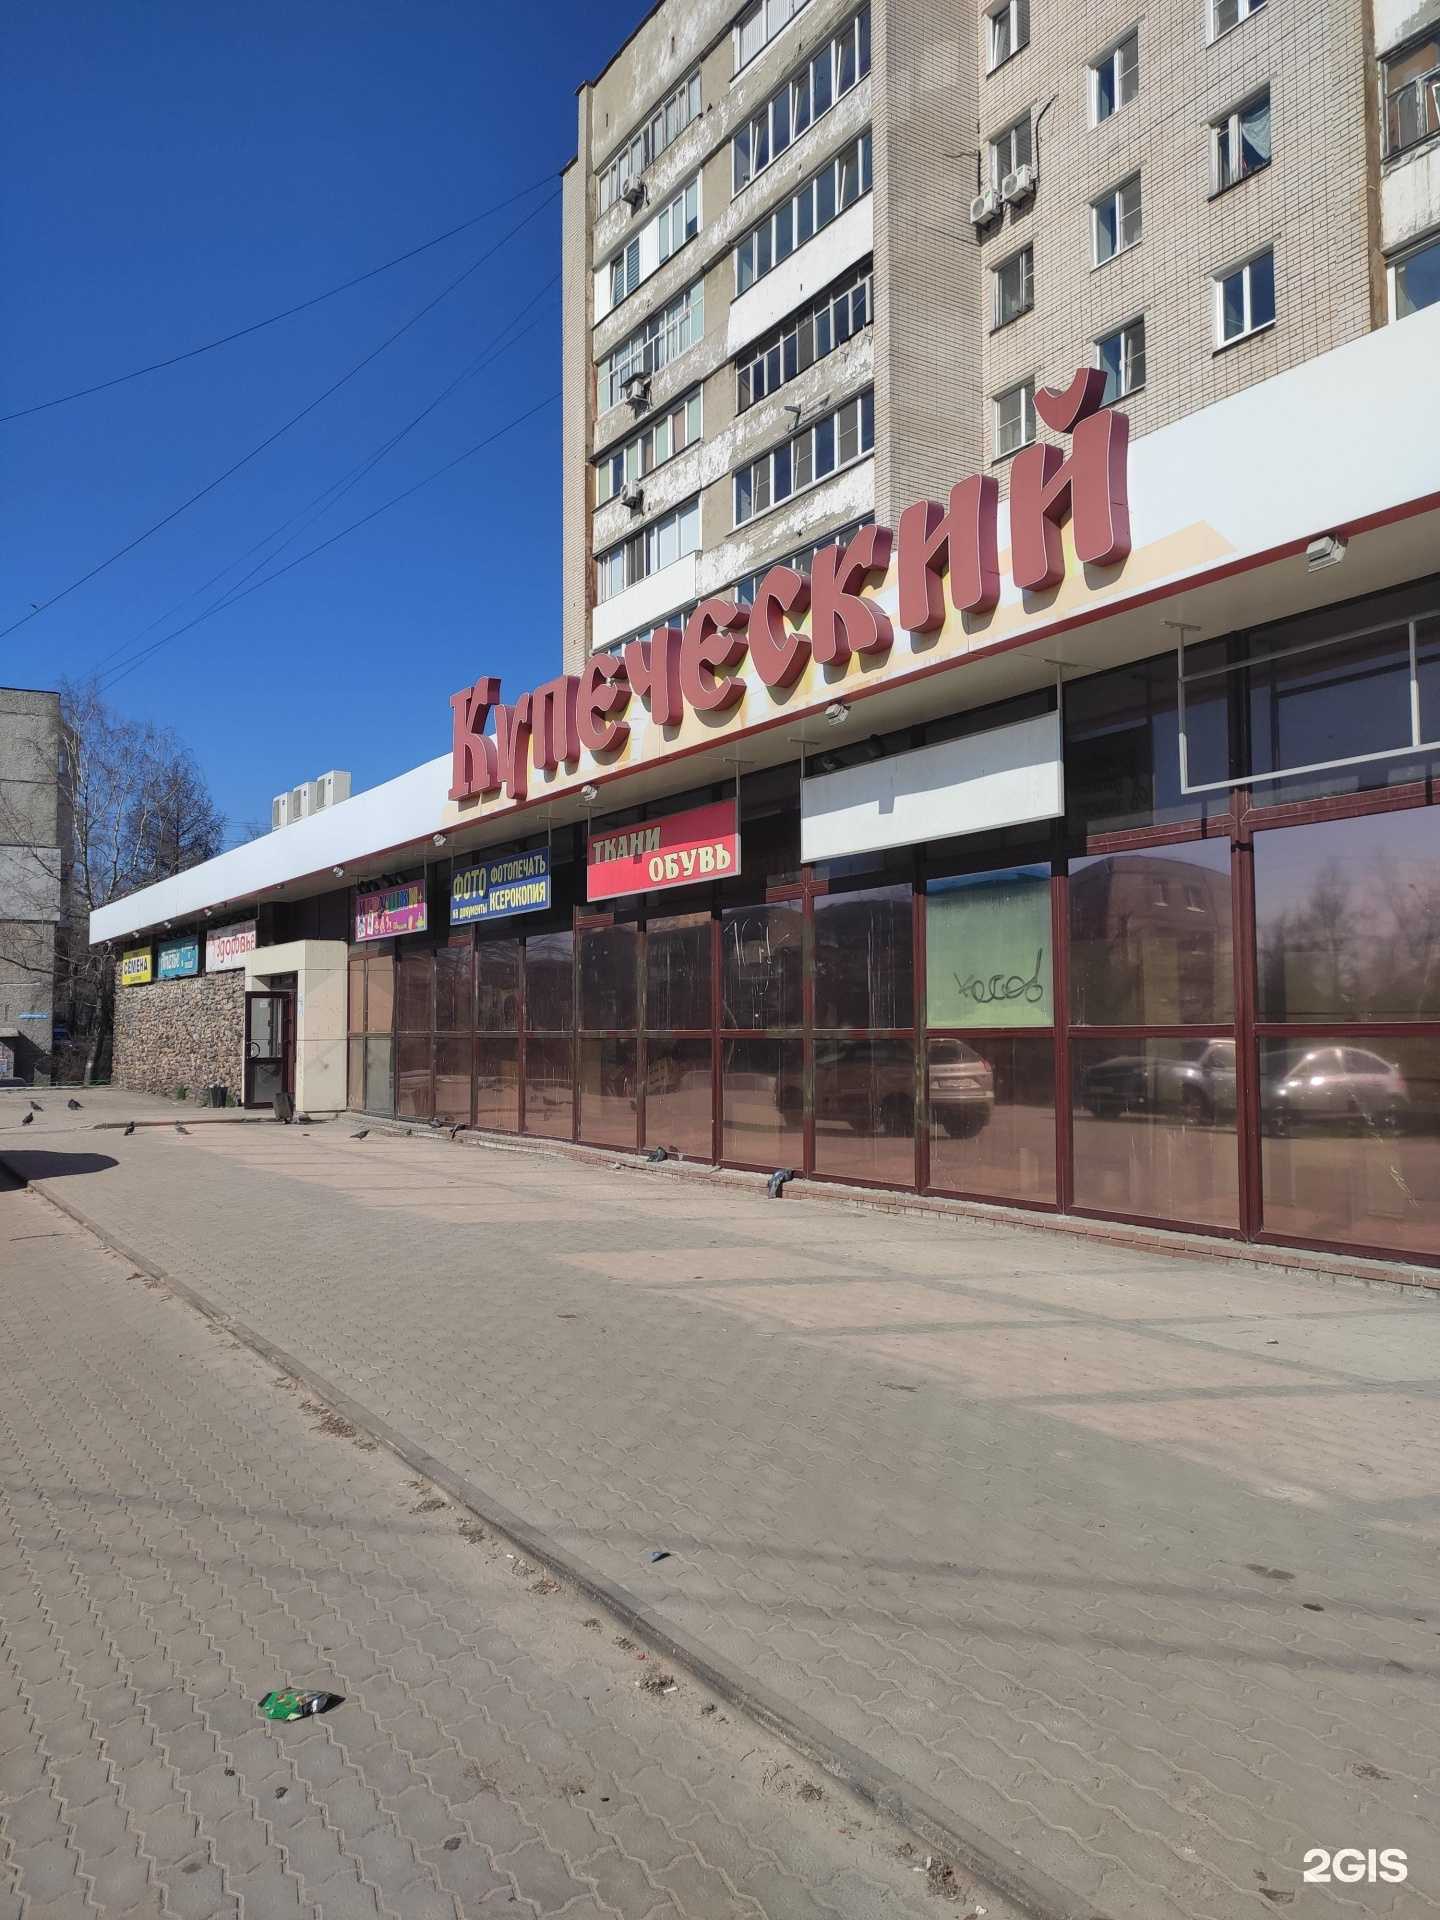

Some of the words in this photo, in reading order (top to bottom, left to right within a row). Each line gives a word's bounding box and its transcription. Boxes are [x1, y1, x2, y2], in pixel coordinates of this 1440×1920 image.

[448, 367, 1131, 803] Купеческий
[592, 826, 662, 864] ТКАНИ
[648, 843, 731, 882] ОБУВЬ
[453, 867, 487, 902] ФОТО
[490, 855, 546, 884] ФОТОПЕЧАТЬ
[488, 881, 546, 911] КСЕРОКОПИЯ
[124, 957, 148, 975] СЕМЕНА
